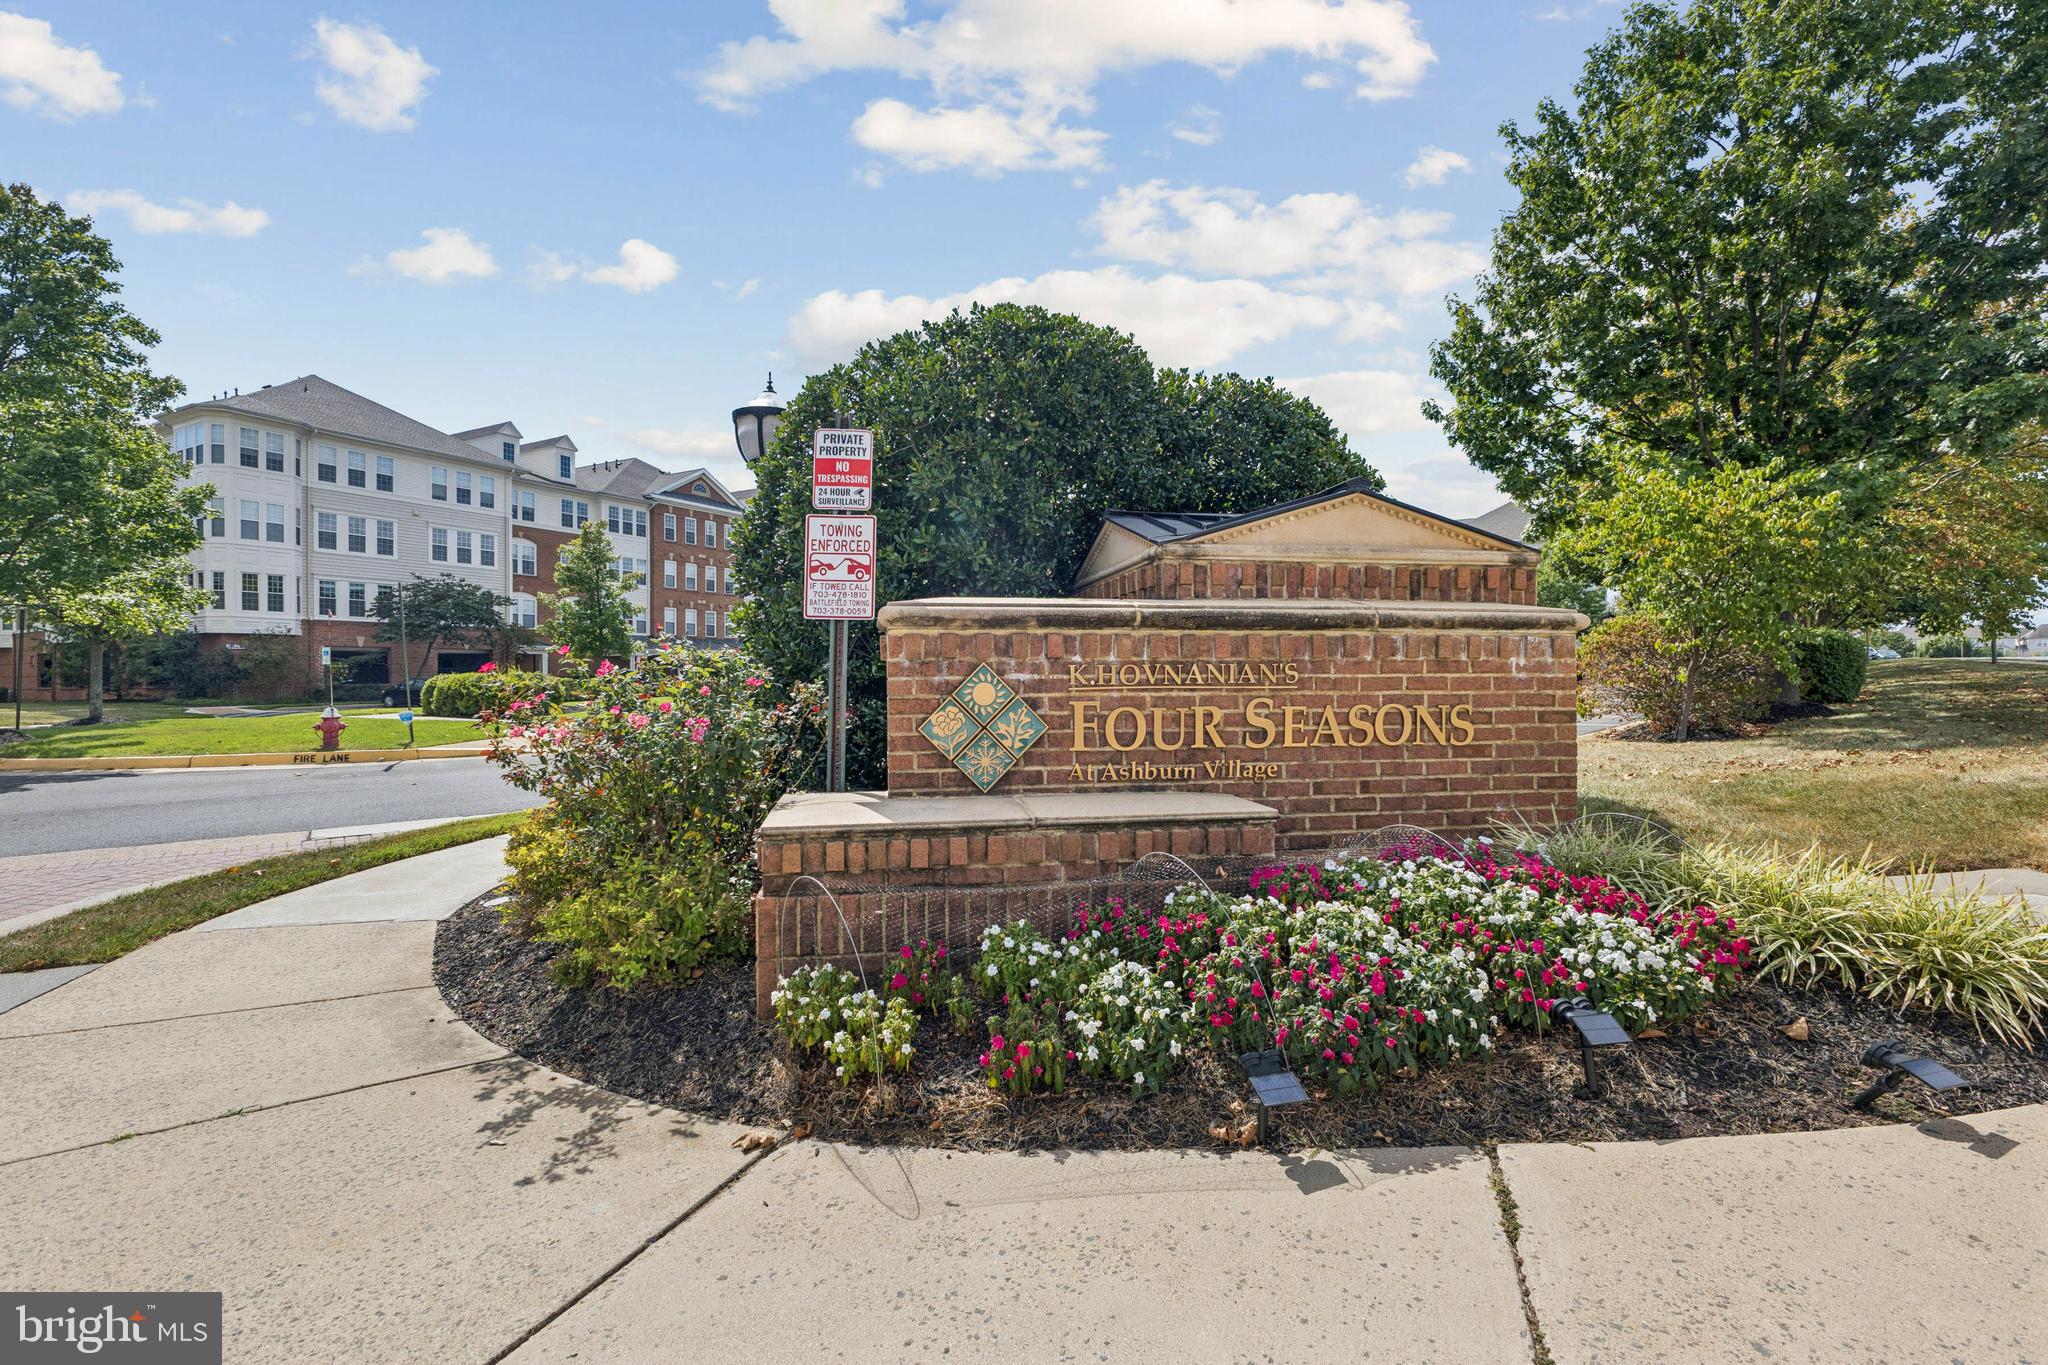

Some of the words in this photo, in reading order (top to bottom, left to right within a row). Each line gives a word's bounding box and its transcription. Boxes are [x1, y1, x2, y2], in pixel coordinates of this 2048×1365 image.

[823, 433, 864, 445] PRIVATE
[819, 446, 867, 457] PROPERTY
[835, 461, 850, 473] NO
[817, 474, 868, 484] TRESPASSING
[818, 488, 828, 497] 24
[830, 488, 851, 497] HOUR
[818, 497, 866, 507] SURVEILLANCE
[820, 524, 863, 538] TOWING
[811, 539, 871, 552] ENFORCED
[849, 583, 870, 591] CALL
[812, 607, 867, 615] 703-378-0059
[1068, 663, 1299, 687] K.HOVNANIAN'S
[1068, 700, 1226, 752] FOUR
[1244, 697, 1475, 749] SEASONS
[294, 755, 317, 763] FIRE
[323, 754, 350, 763] LANE
[1068, 763, 1096, 781] At
[1101, 761, 1197, 781] Ashburn
[1202, 759, 1279, 784] Village
